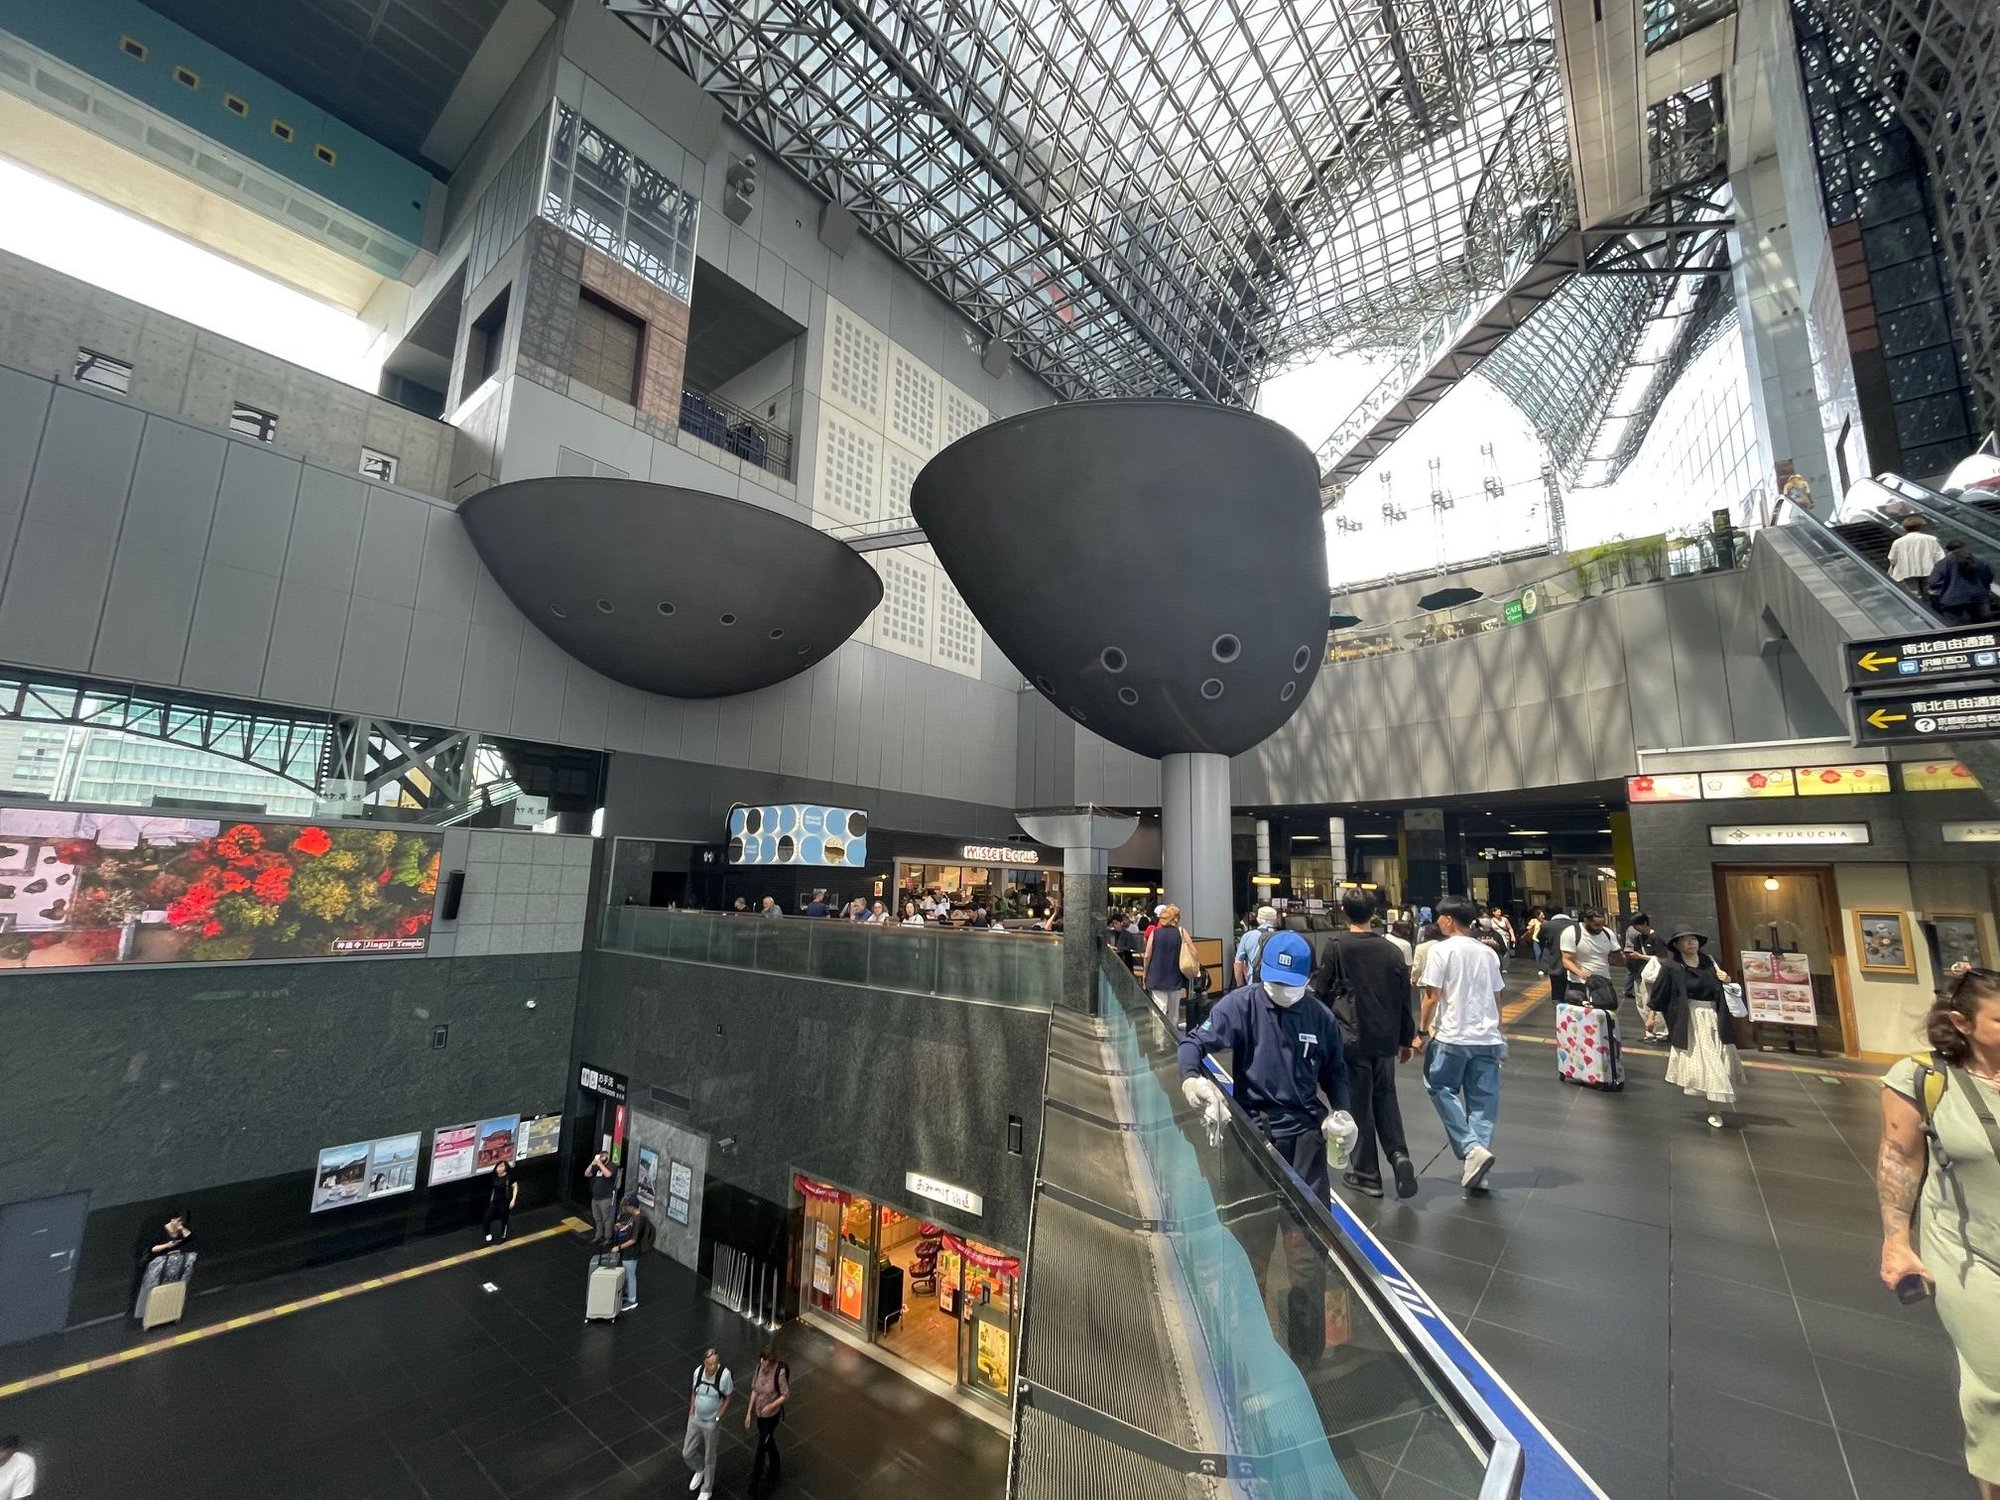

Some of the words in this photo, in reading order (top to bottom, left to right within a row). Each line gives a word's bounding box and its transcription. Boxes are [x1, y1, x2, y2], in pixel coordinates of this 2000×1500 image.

[1901, 635, 1995, 655] 南北自由通路
[365, 940, 393, 950] Jingoji
[397, 939, 422, 949] Temple
